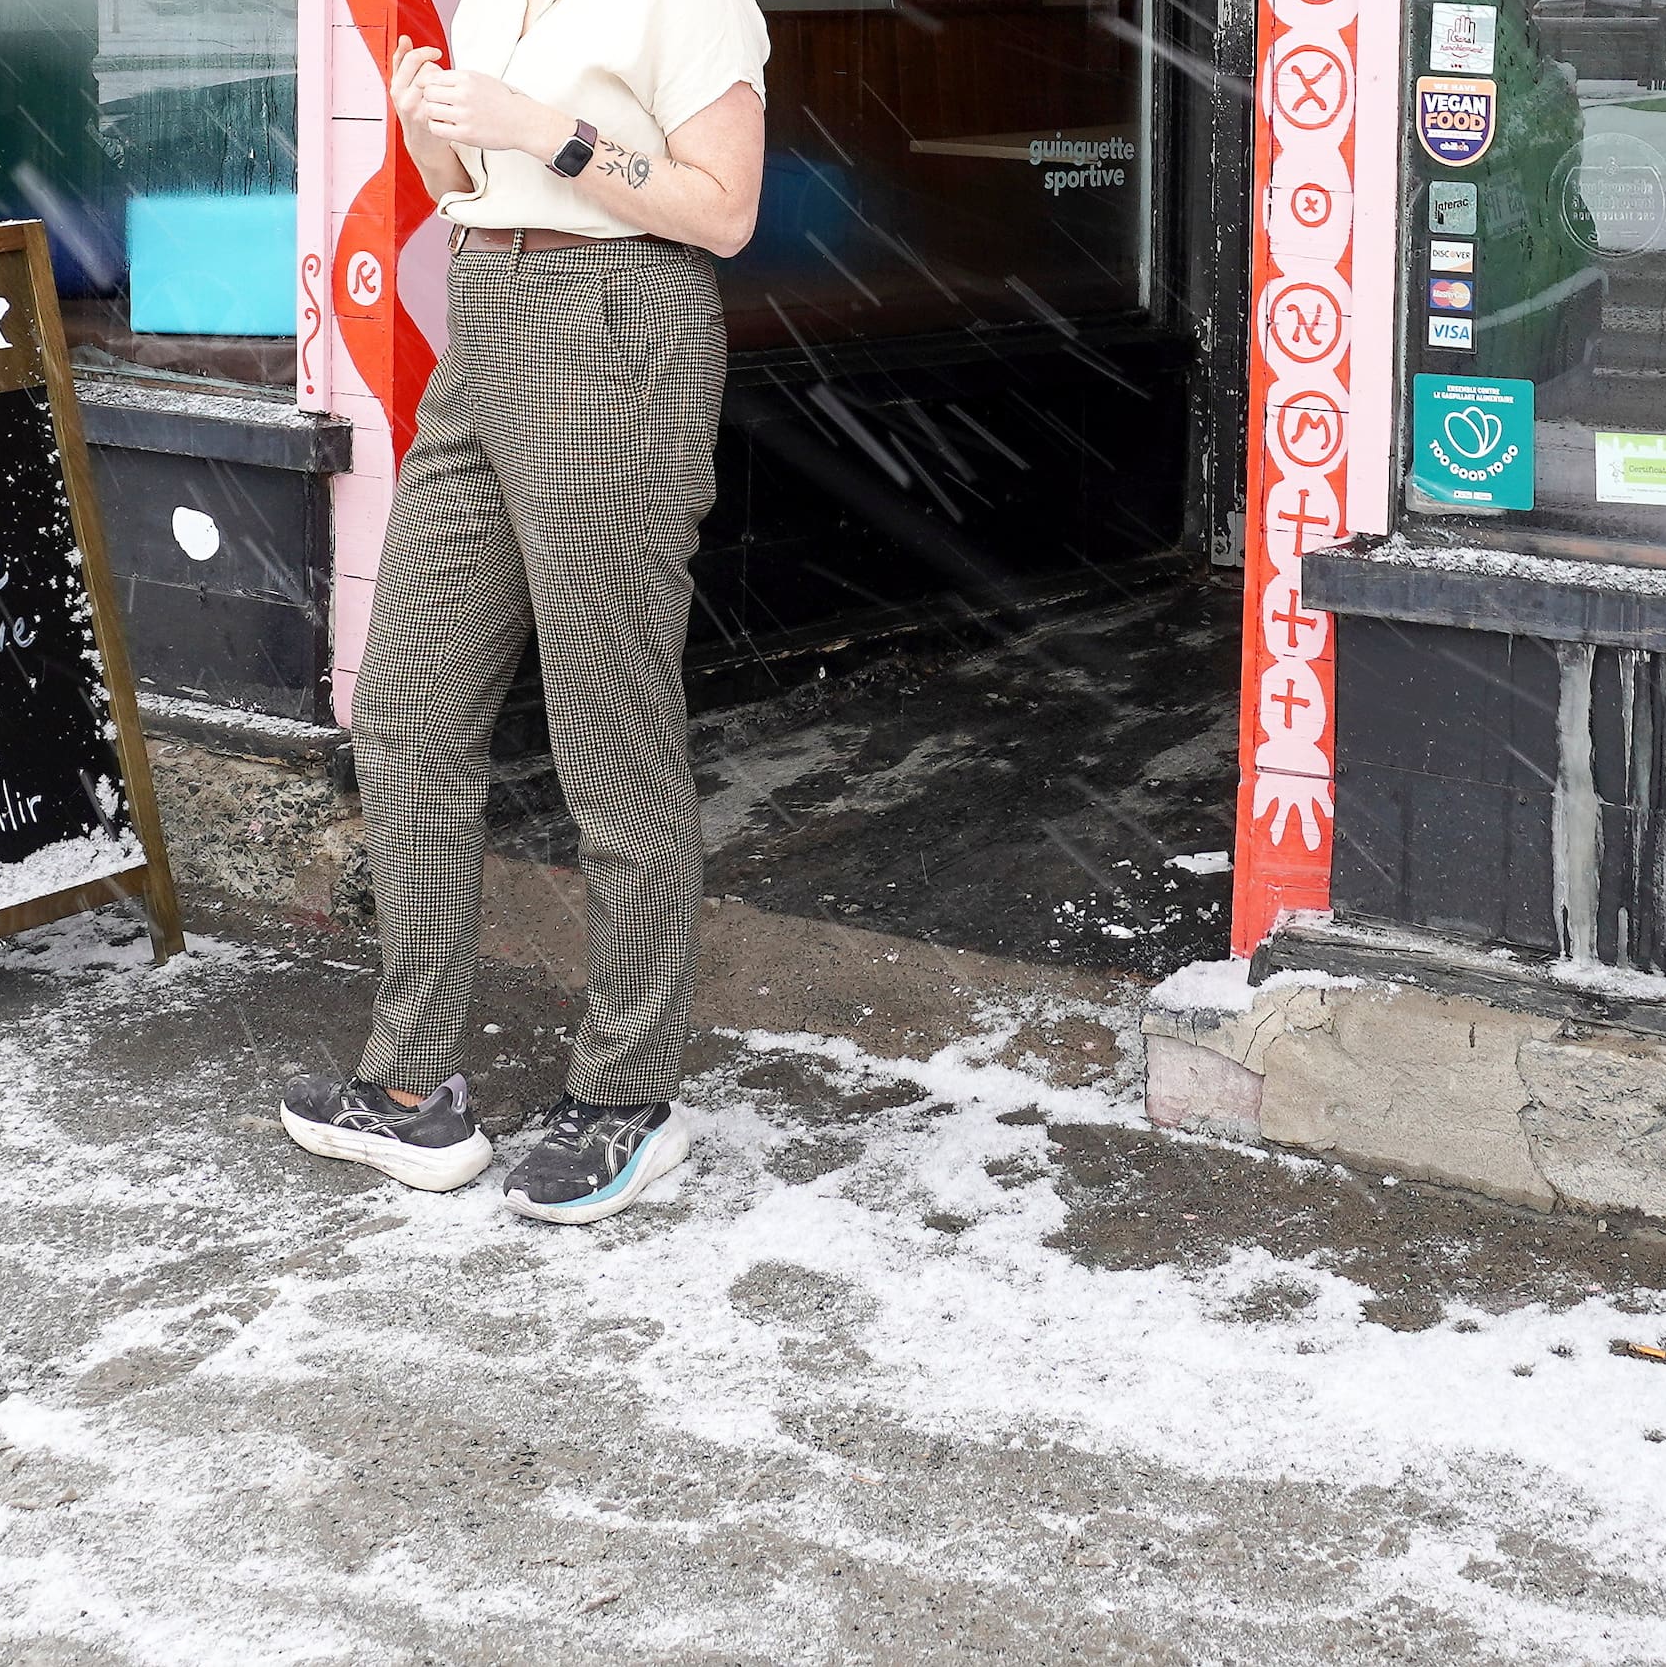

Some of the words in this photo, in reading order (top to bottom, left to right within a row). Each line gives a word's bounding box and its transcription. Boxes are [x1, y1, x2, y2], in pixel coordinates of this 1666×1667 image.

[1423, 93, 1487, 117] VEGAN
[1425, 111, 1487, 132] FOOD
[1029, 131, 1135, 166] guinguette
[1044, 160, 1126, 196] sportive
[1435, 197, 1469, 212] Interac
[1432, 248, 1471, 260] DISCOVER
[1434, 323, 1470, 340] VISA
[1429, 439, 1451, 467] TOO
[1449, 462, 1488, 482] GOOD
[1486, 463, 1505, 477] TO
[1501, 444, 1520, 465] GO
